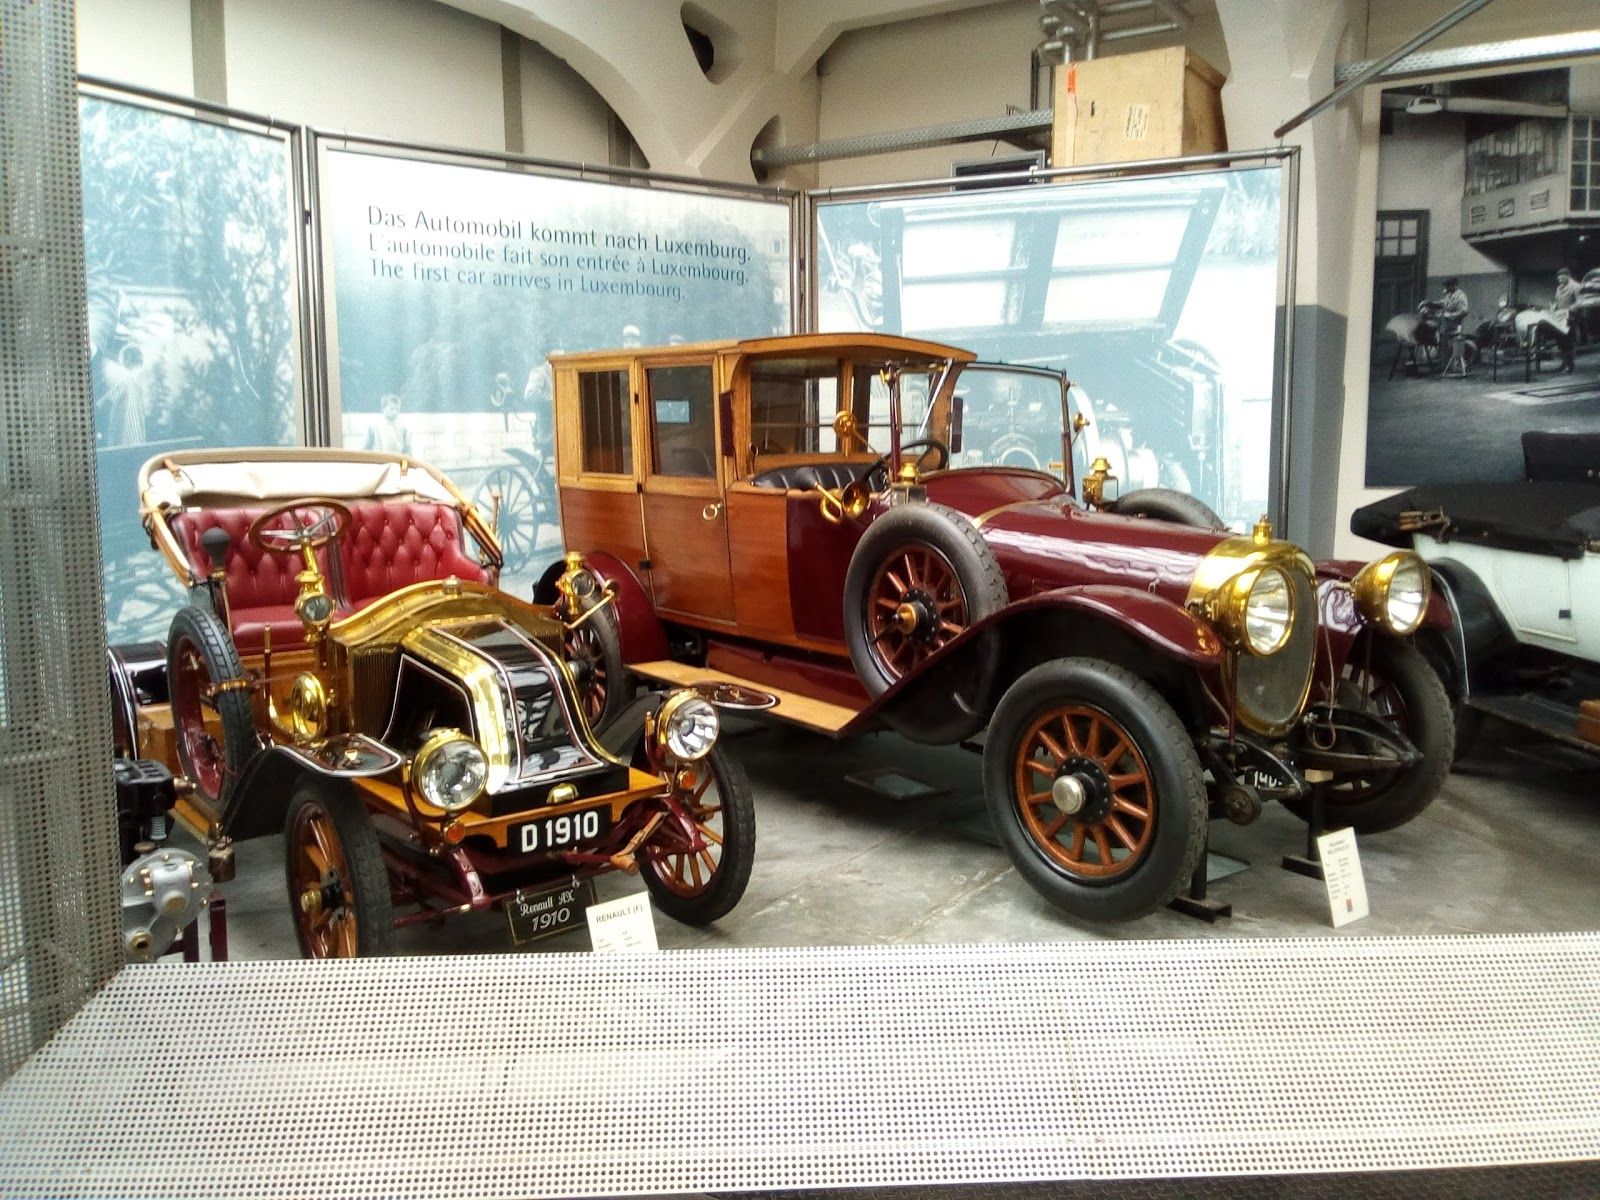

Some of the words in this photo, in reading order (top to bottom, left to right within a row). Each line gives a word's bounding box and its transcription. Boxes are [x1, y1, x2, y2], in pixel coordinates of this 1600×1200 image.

[367, 204, 406, 229] Das
[415, 210, 522, 239] Automobil
[531, 221, 596, 247] kommt
[605, 232, 648, 251] nach
[655, 234, 751, 265] Luxemburg.
[369, 257, 404, 279] The
[413, 261, 450, 283] first
[457, 269, 485, 284] car
[493, 270, 551, 290] arrives
[558, 275, 573, 291] in
[581, 275, 686, 302] Luxembourg.
[503, 244, 533, 266] fait
[540, 254, 569, 269] son
[576, 254, 630, 273] entrée
[637, 257, 646, 274] à
[652, 258, 749, 286] Luxembourg.
[521, 823, 538, 854] D
[545, 811, 599, 848] 1910
[520, 895, 554, 917] Renault
[532, 907, 571, 932] 1910
[595, 907, 632, 924] RENAULT
